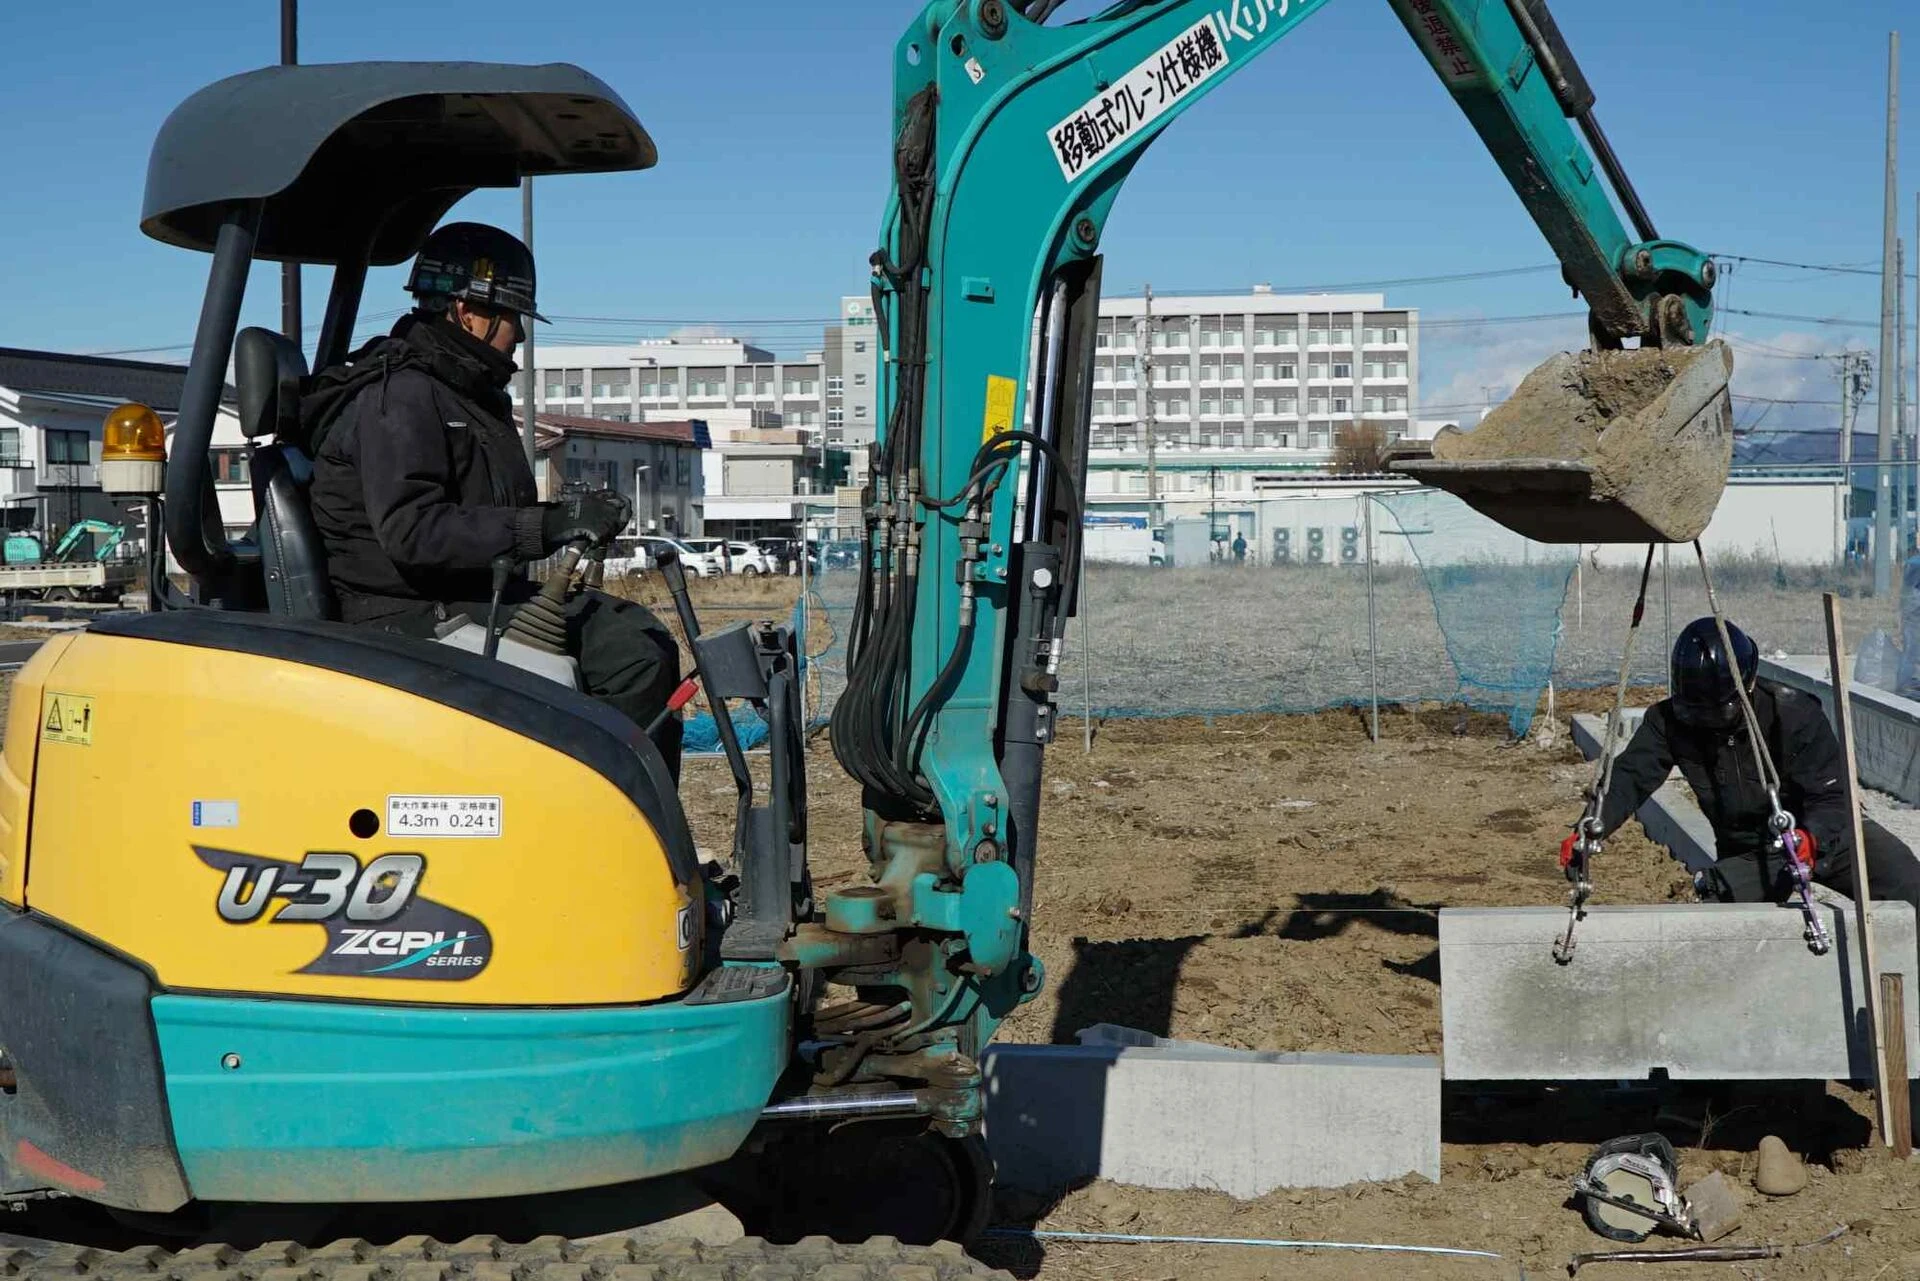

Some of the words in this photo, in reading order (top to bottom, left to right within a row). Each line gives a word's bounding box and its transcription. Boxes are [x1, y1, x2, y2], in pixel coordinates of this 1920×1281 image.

[1054, 24, 1222, 173] 移動式クレーン仕様機
[399, 814, 439, 827] 4.3m
[449, 814, 484, 828] 0.24
[489, 817, 494, 828] t
[217, 854, 423, 920] U-30
[426, 956, 483, 966] SERIES
